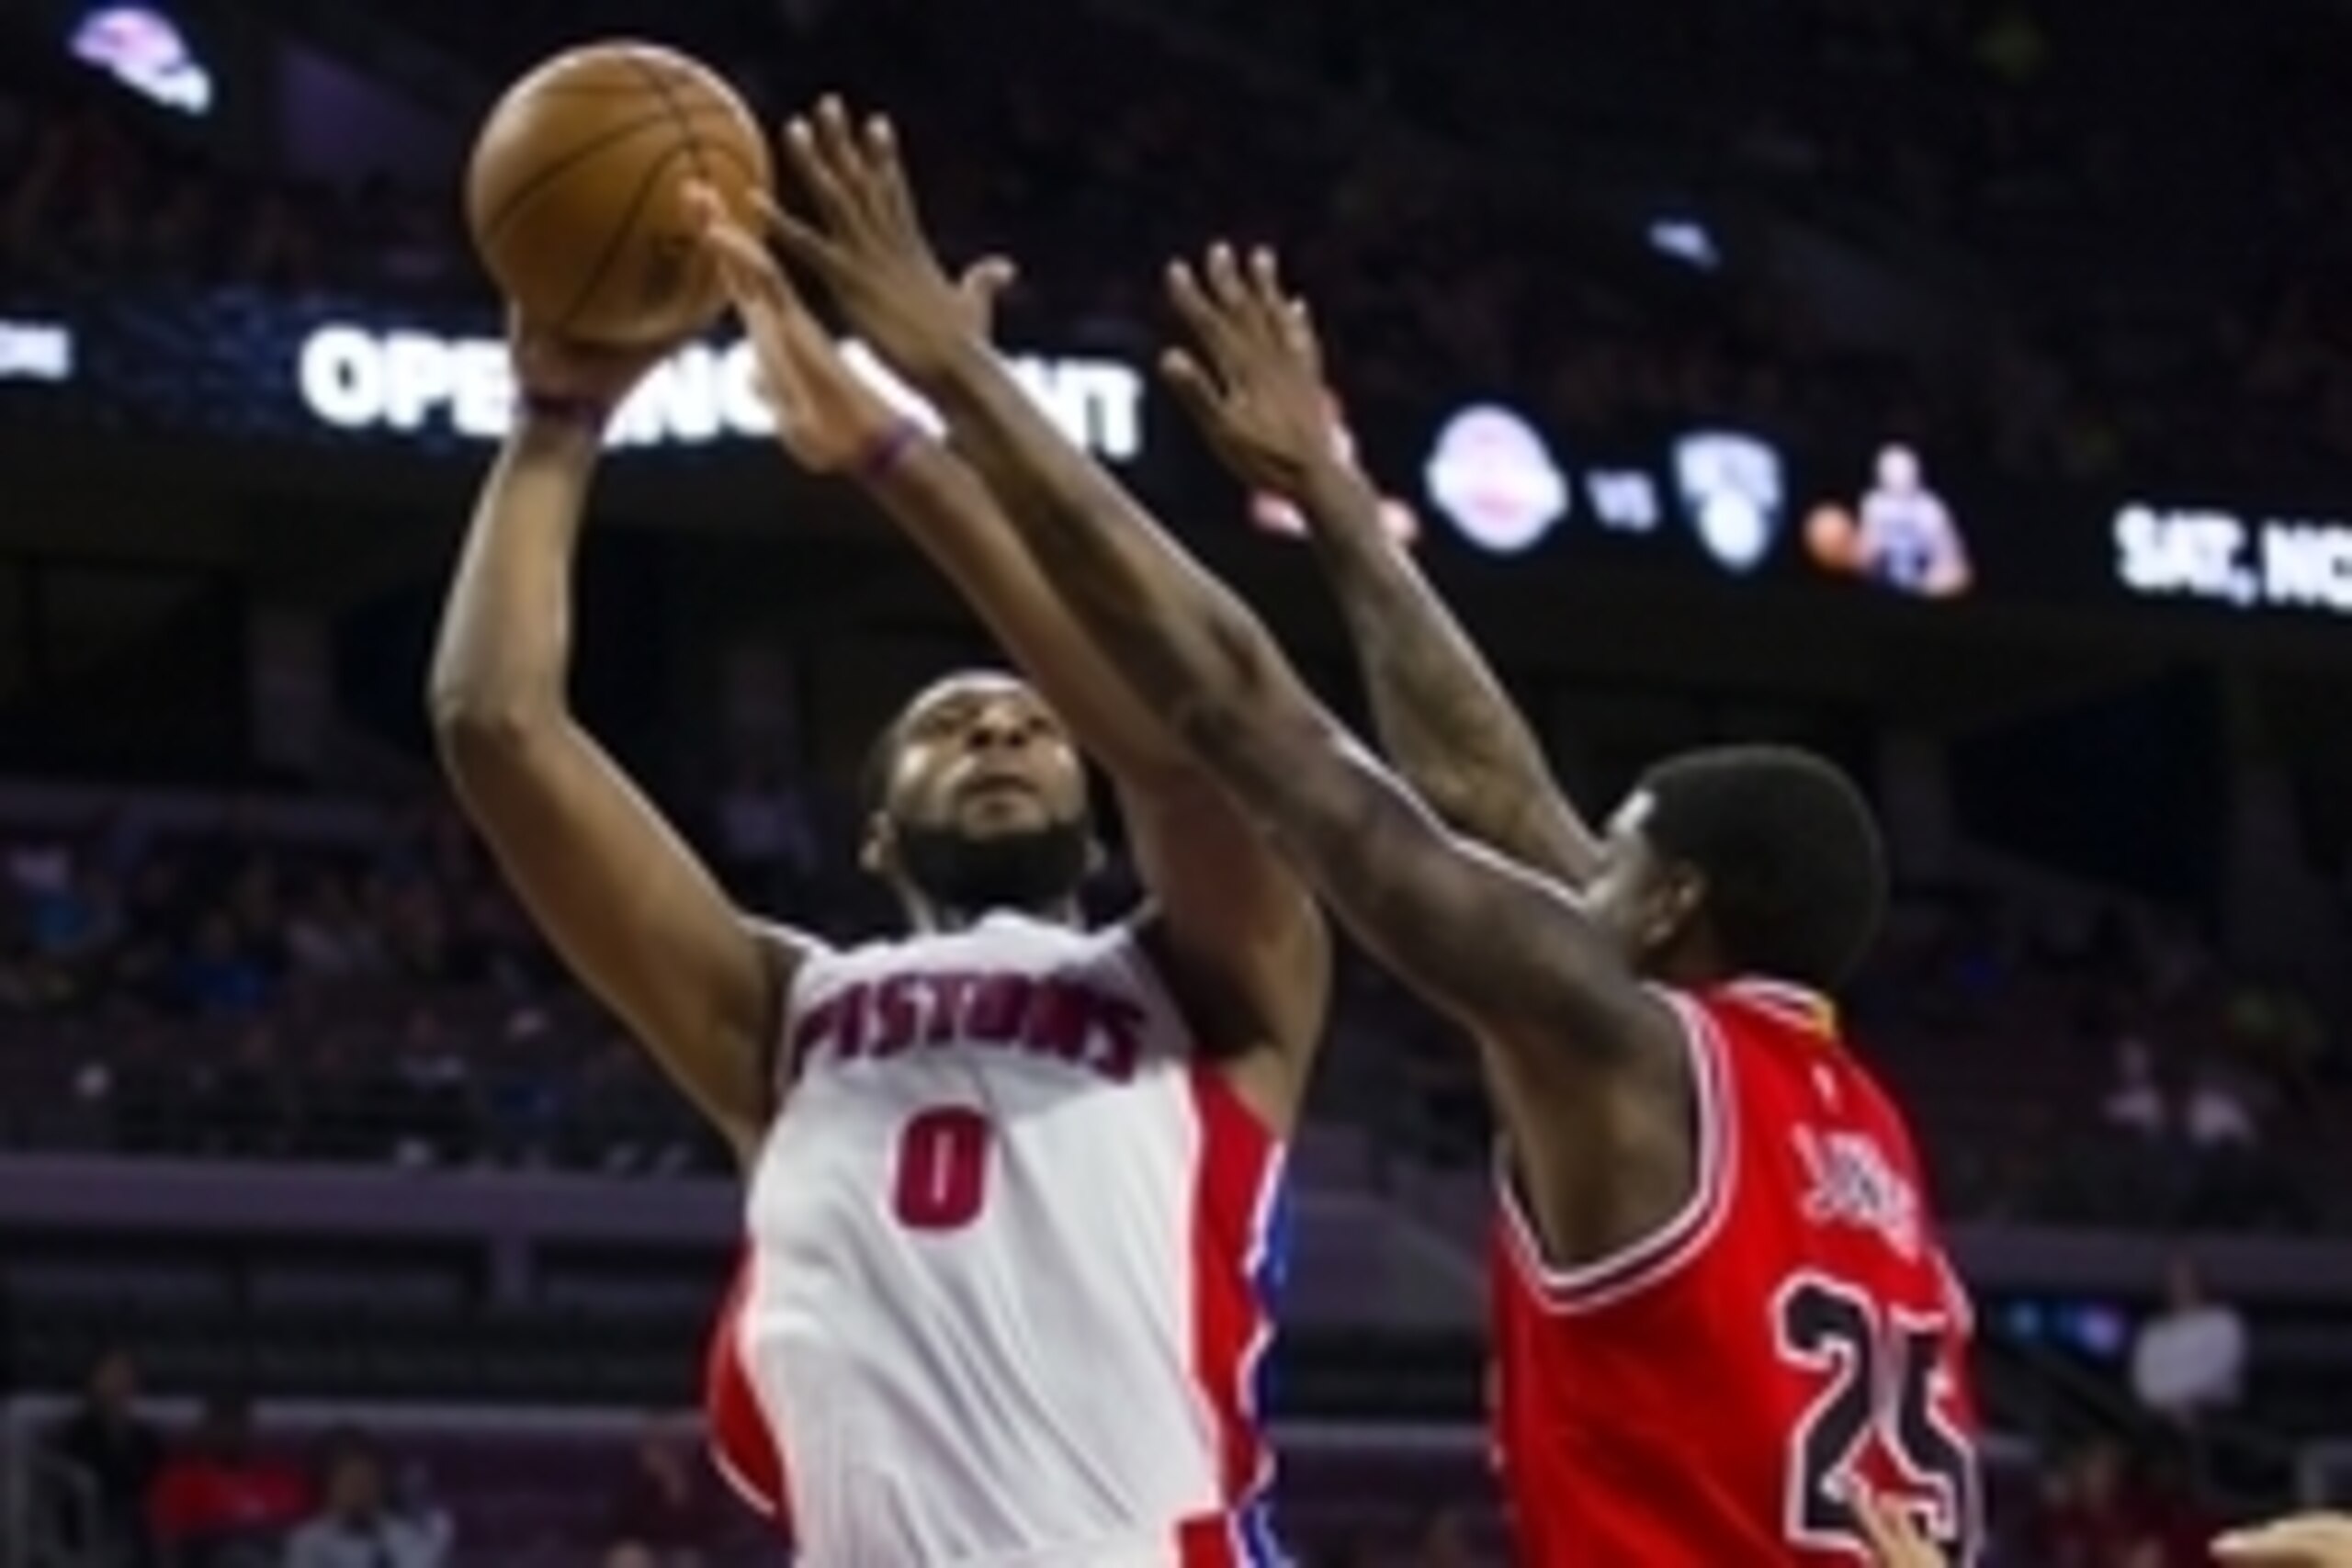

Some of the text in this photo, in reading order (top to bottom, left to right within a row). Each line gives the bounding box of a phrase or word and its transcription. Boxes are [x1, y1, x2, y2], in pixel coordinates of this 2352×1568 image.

[788, 969, 1144, 1086] PISTONS
[891, 1102, 990, 1233] 0
[1770, 1271, 1983, 1568] 25
